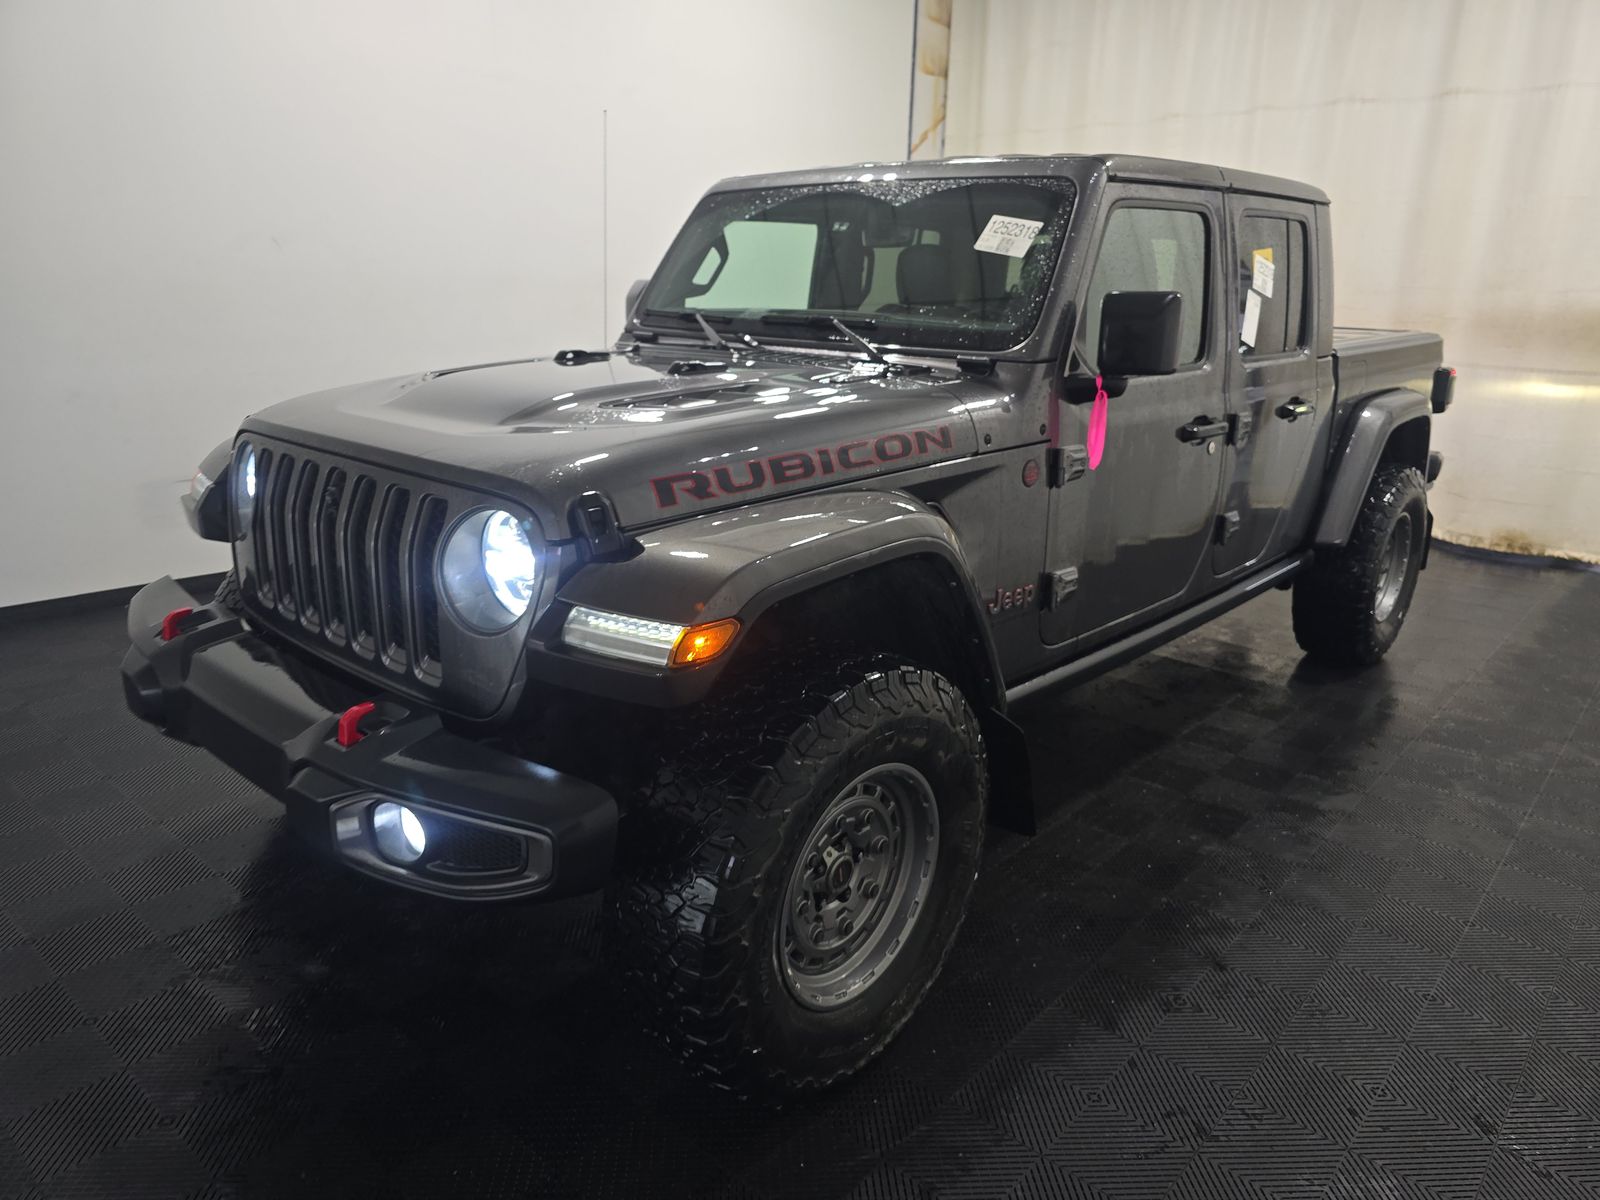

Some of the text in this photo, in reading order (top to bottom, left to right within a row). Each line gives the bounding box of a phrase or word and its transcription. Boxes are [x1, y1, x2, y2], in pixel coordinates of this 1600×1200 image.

[988, 220, 1040, 240] 1252318
[649, 423, 954, 509] RUBICON
[987, 583, 1035, 615] Jeep
